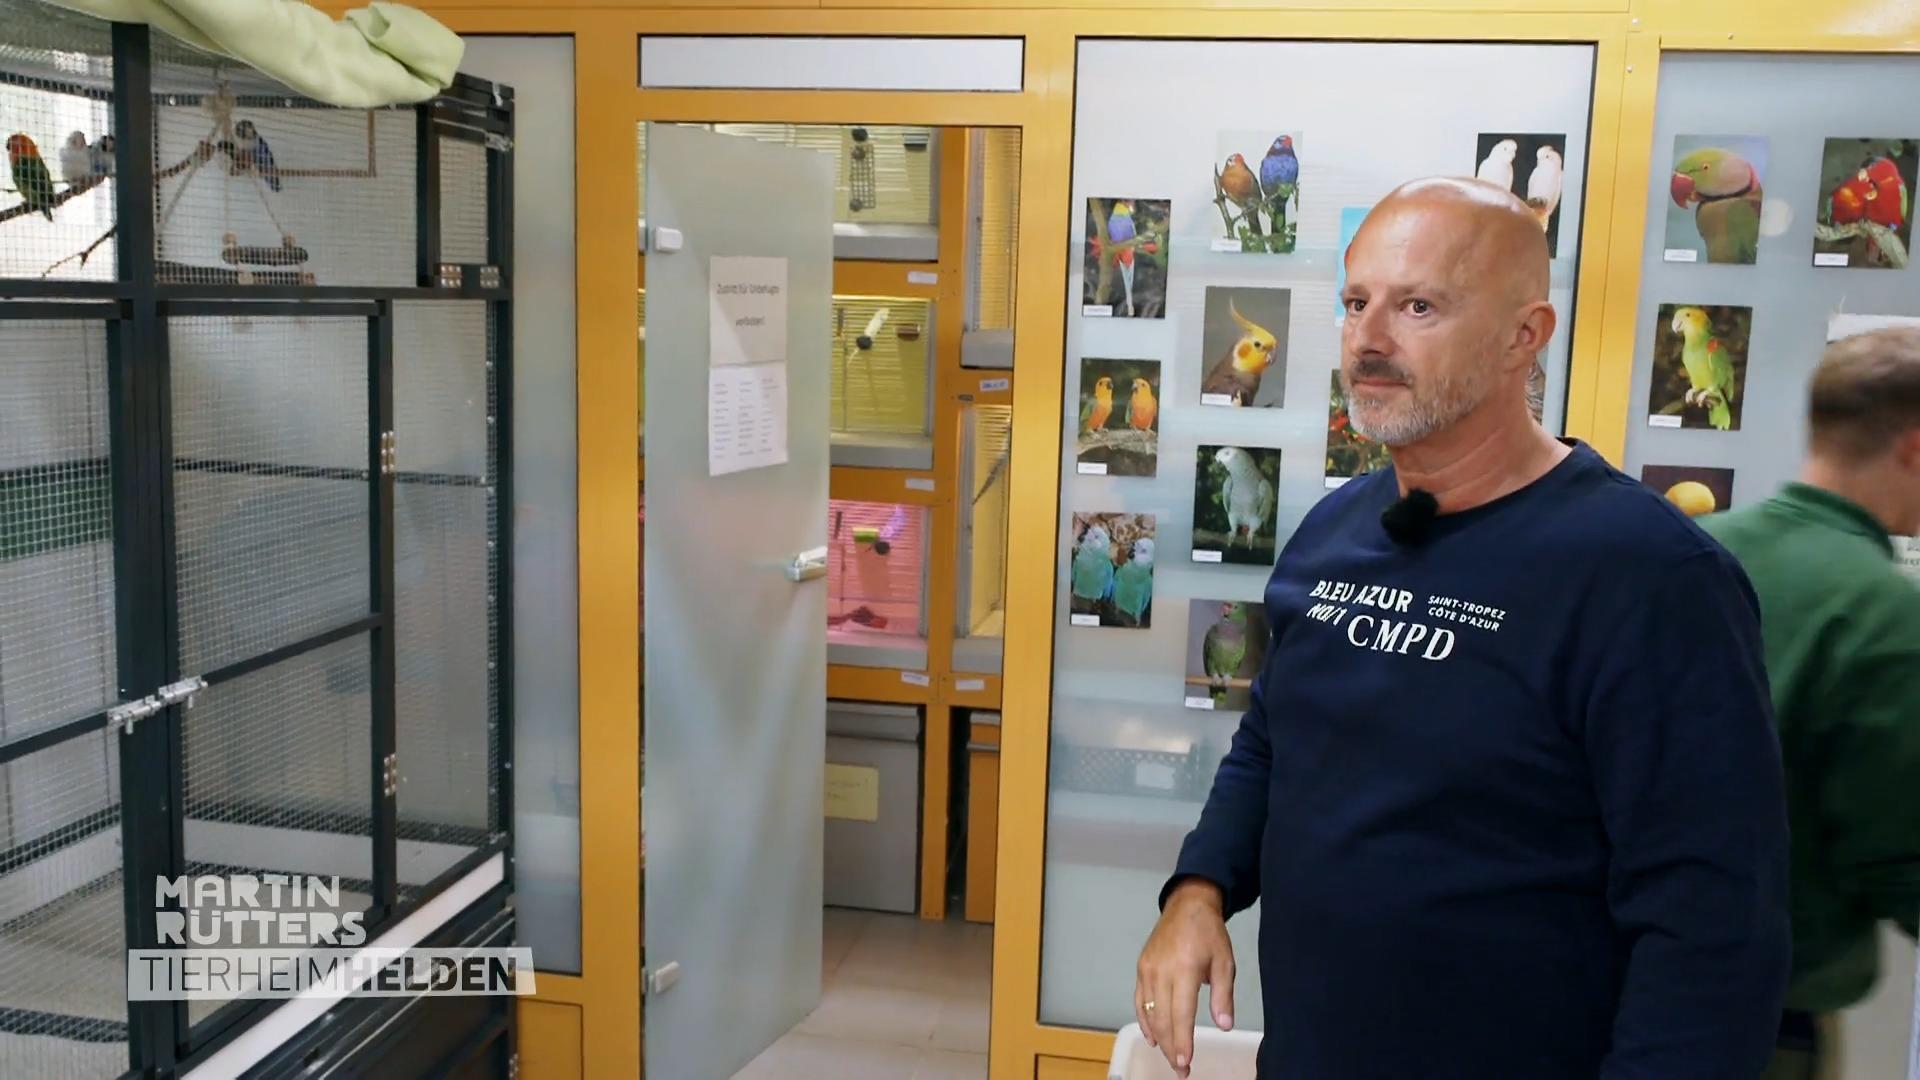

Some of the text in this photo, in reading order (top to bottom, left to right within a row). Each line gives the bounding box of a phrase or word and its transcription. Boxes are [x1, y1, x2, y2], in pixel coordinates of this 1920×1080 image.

[1309, 580, 1414, 613] BLEU AZUR
[1428, 596, 1506, 620] SAINT-TROPEZ
[1428, 606, 1500, 632] CÔTE D'AZUR
[1347, 614, 1455, 661] CMPD
